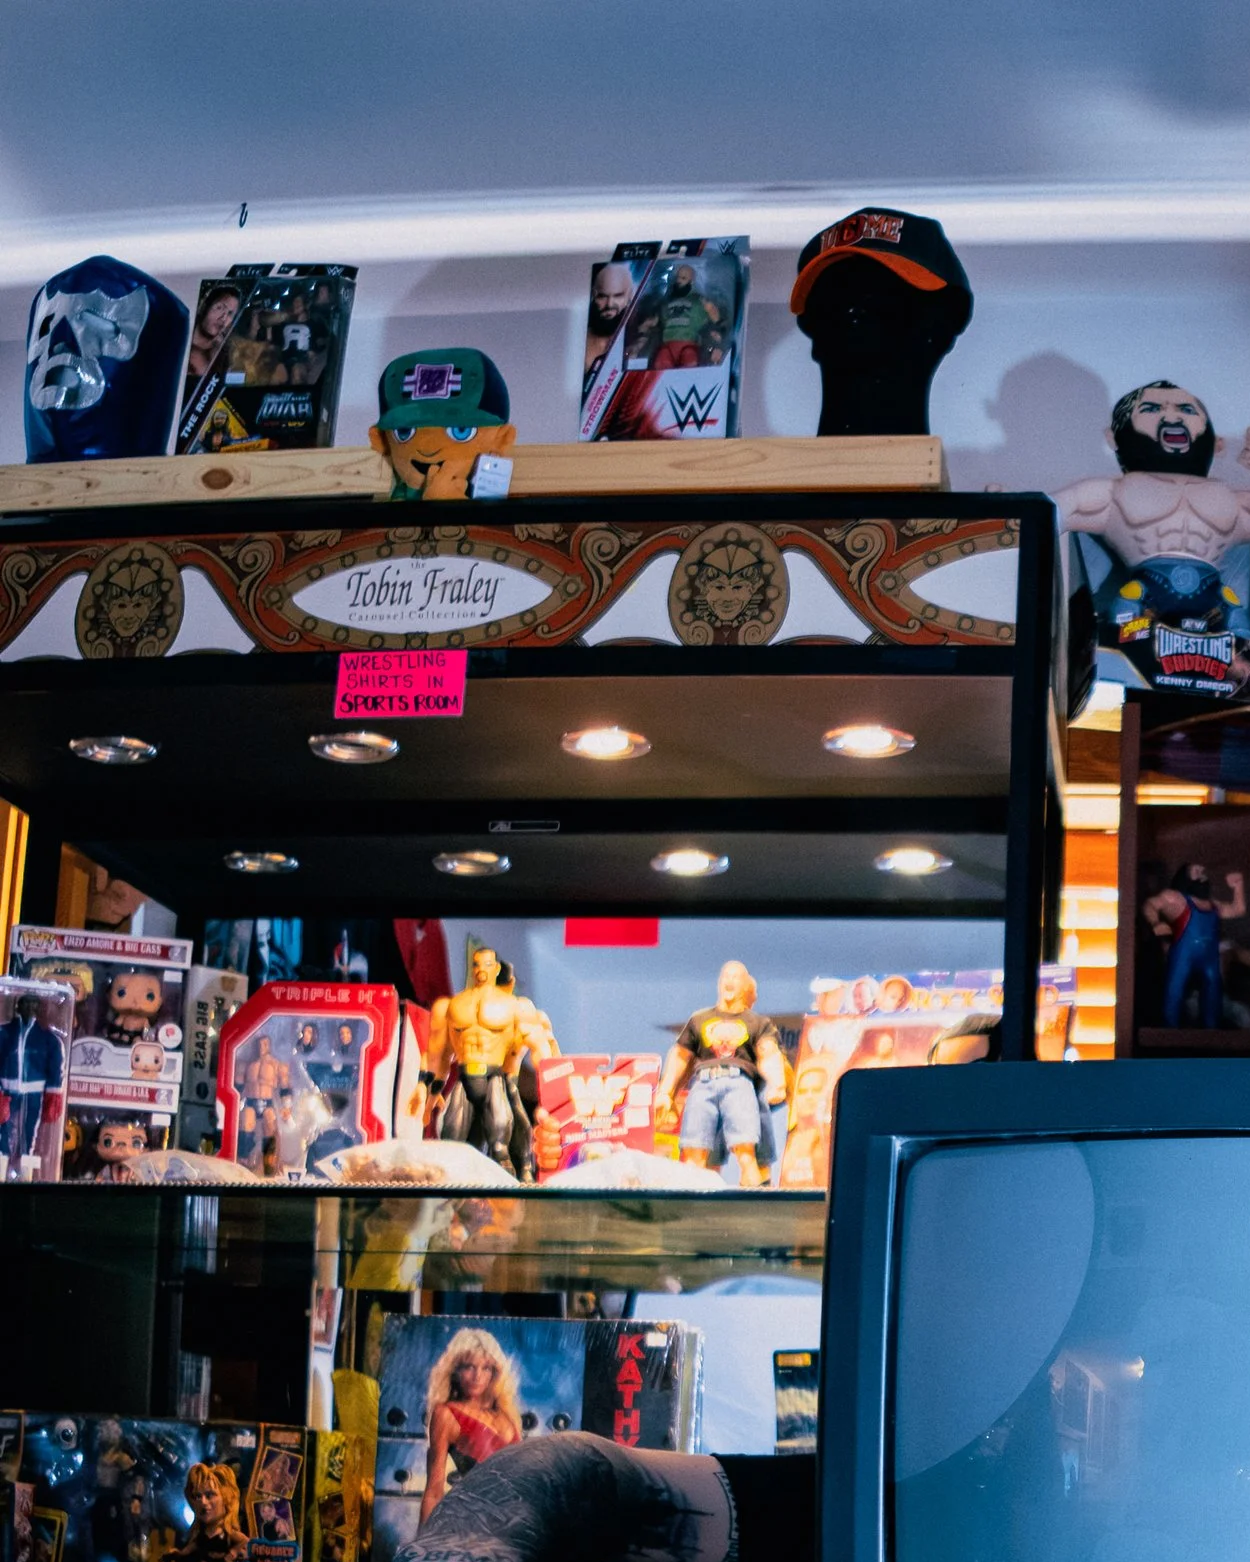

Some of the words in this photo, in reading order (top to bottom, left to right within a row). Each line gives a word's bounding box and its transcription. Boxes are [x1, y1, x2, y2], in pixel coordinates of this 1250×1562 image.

[180, 415, 198, 438] THE
[196, 374, 220, 414] ROCK
[411, 561, 426, 569] the
[347, 565, 413, 608] Tobin
[418, 562, 500, 618] Fraley
[1159, 628, 1232, 664] WRESTLING
[343, 652, 446, 671] WRESTLING
[1161, 654, 1229, 681] BUDDIES
[346, 674, 413, 689] SHIRTS
[427, 676, 444, 688] IN
[1156, 676, 1194, 687] KENNY
[1196, 680, 1234, 692] OMEGA
[340, 694, 409, 713] SPORTS
[414, 695, 459, 711] ROOM
[64, 935, 85, 947] ENZO
[86, 937, 115, 949] AMORE
[140, 943, 162, 954] CASS
[271, 986, 351, 1002] TRIPLE
[358, 990, 374, 1004] H
